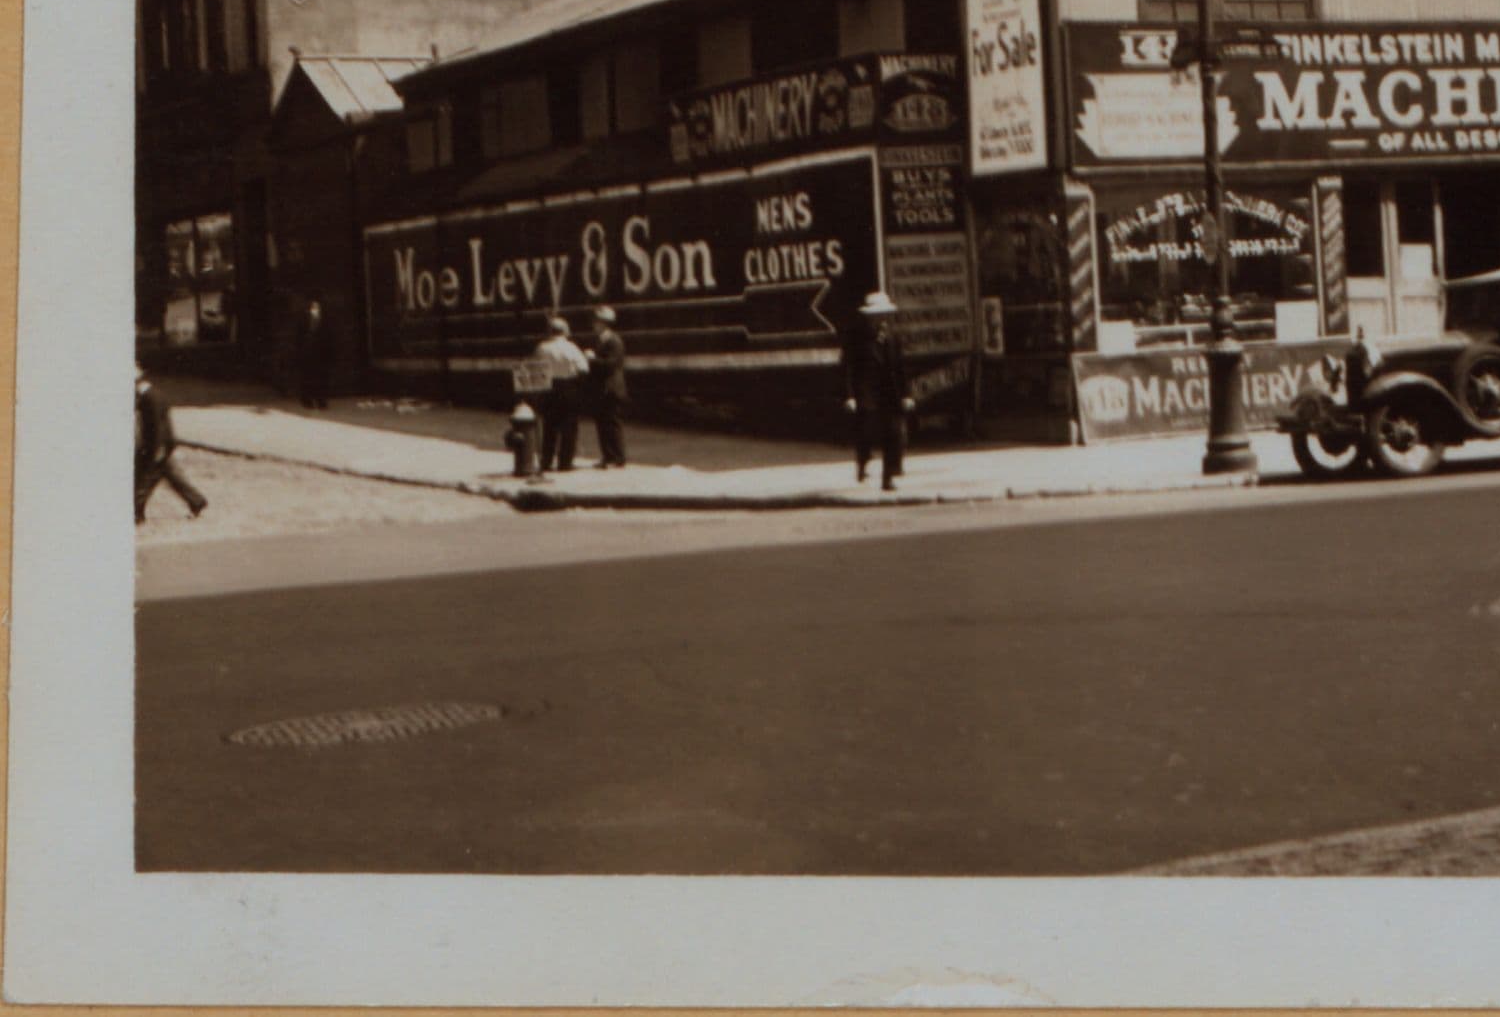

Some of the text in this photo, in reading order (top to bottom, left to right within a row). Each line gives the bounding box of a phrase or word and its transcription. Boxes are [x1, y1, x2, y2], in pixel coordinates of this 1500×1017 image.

[997, 18, 1036, 71] Sale
[1273, 33, 1466, 66] FINKELSTEIN
[710, 72, 818, 154] MACHINERY
[1378, 133, 1406, 151] OF
[1410, 132, 1448, 151] ALL
[393, 216, 716, 310] Moe Levy & Son
[745, 239, 844, 283] CLOTHES
